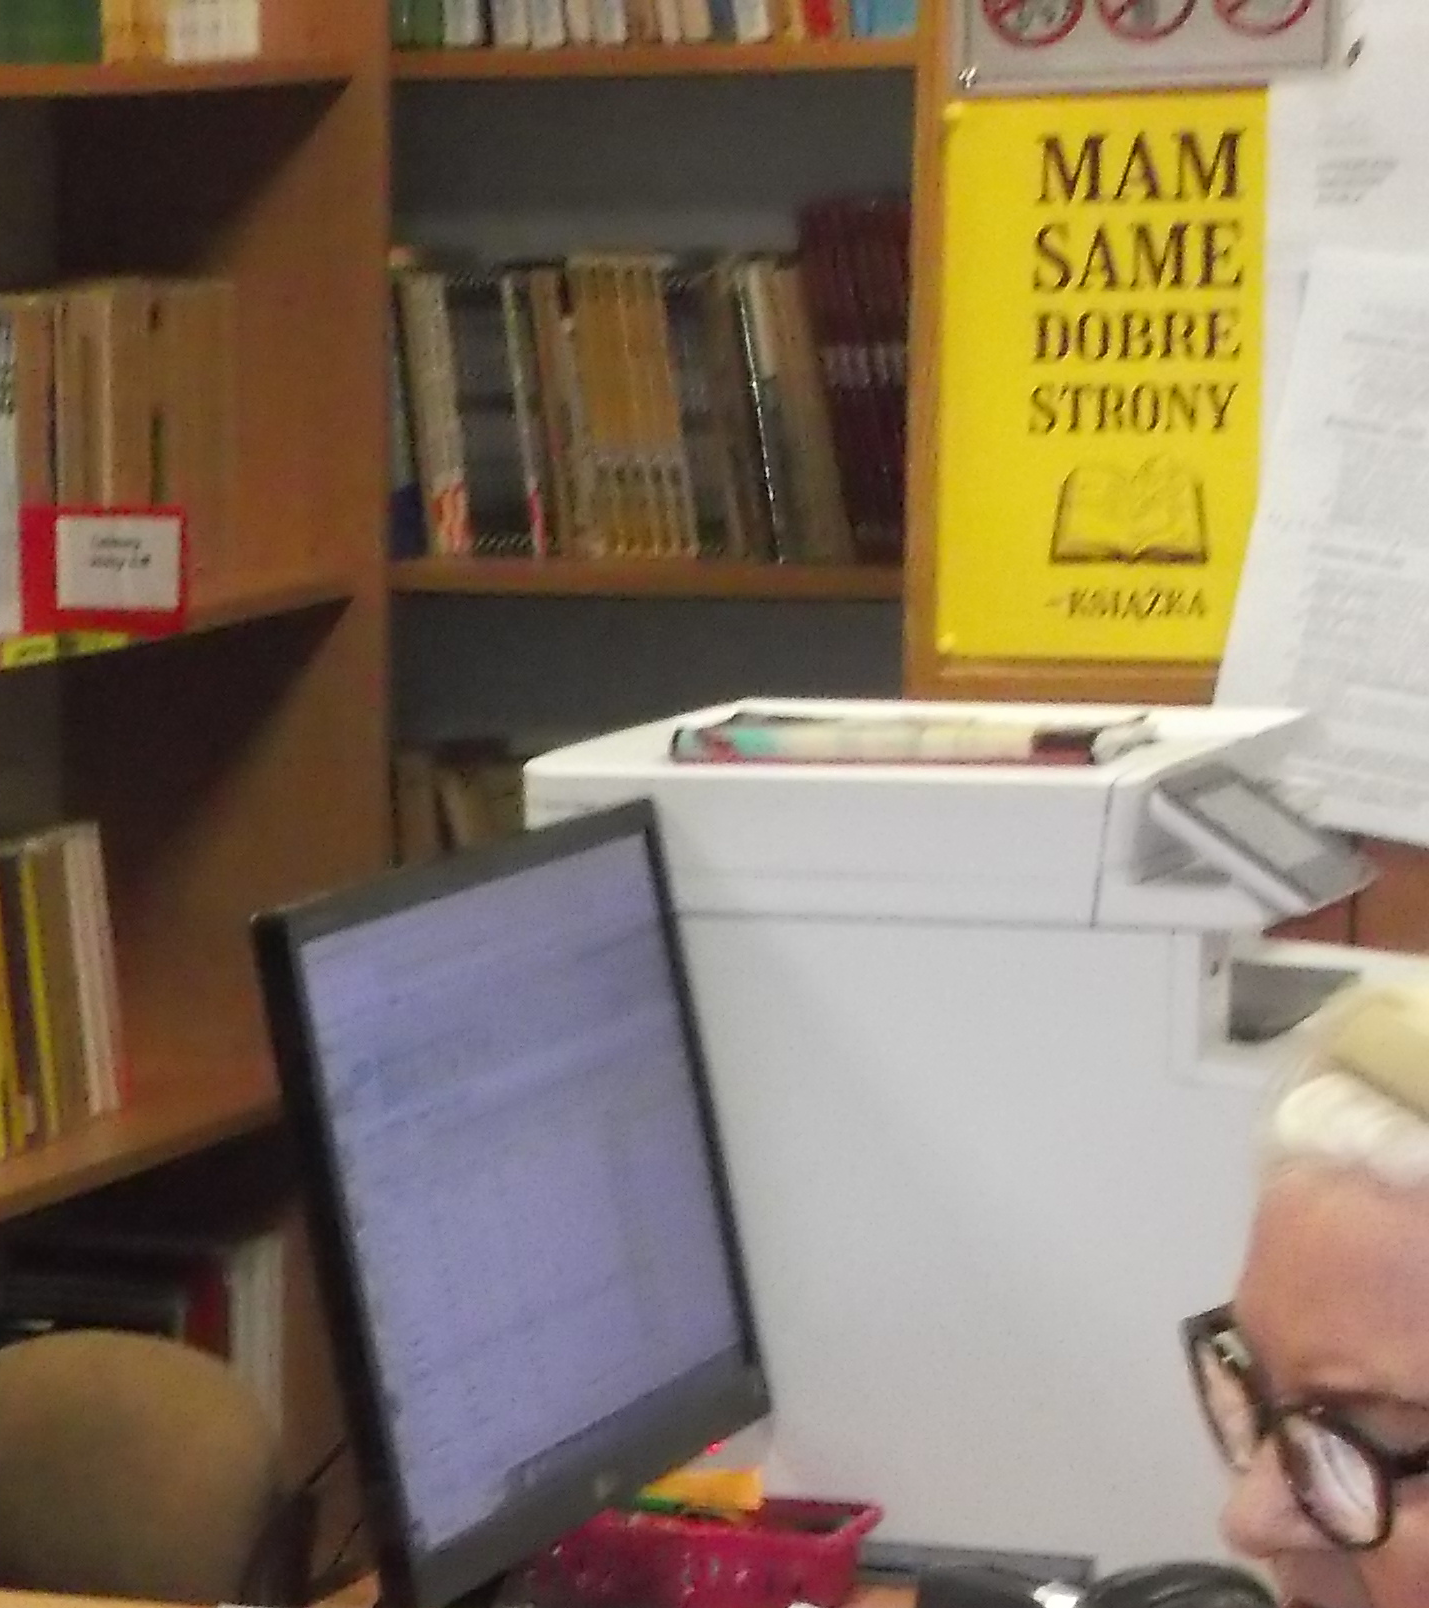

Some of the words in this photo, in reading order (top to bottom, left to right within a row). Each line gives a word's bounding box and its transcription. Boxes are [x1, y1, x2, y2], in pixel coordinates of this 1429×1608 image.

[1036, 130, 1245, 203] MAM
[1032, 220, 1243, 292] SAME
[1033, 309, 1242, 362] DOBRE
[1027, 381, 1239, 435] STRONY
